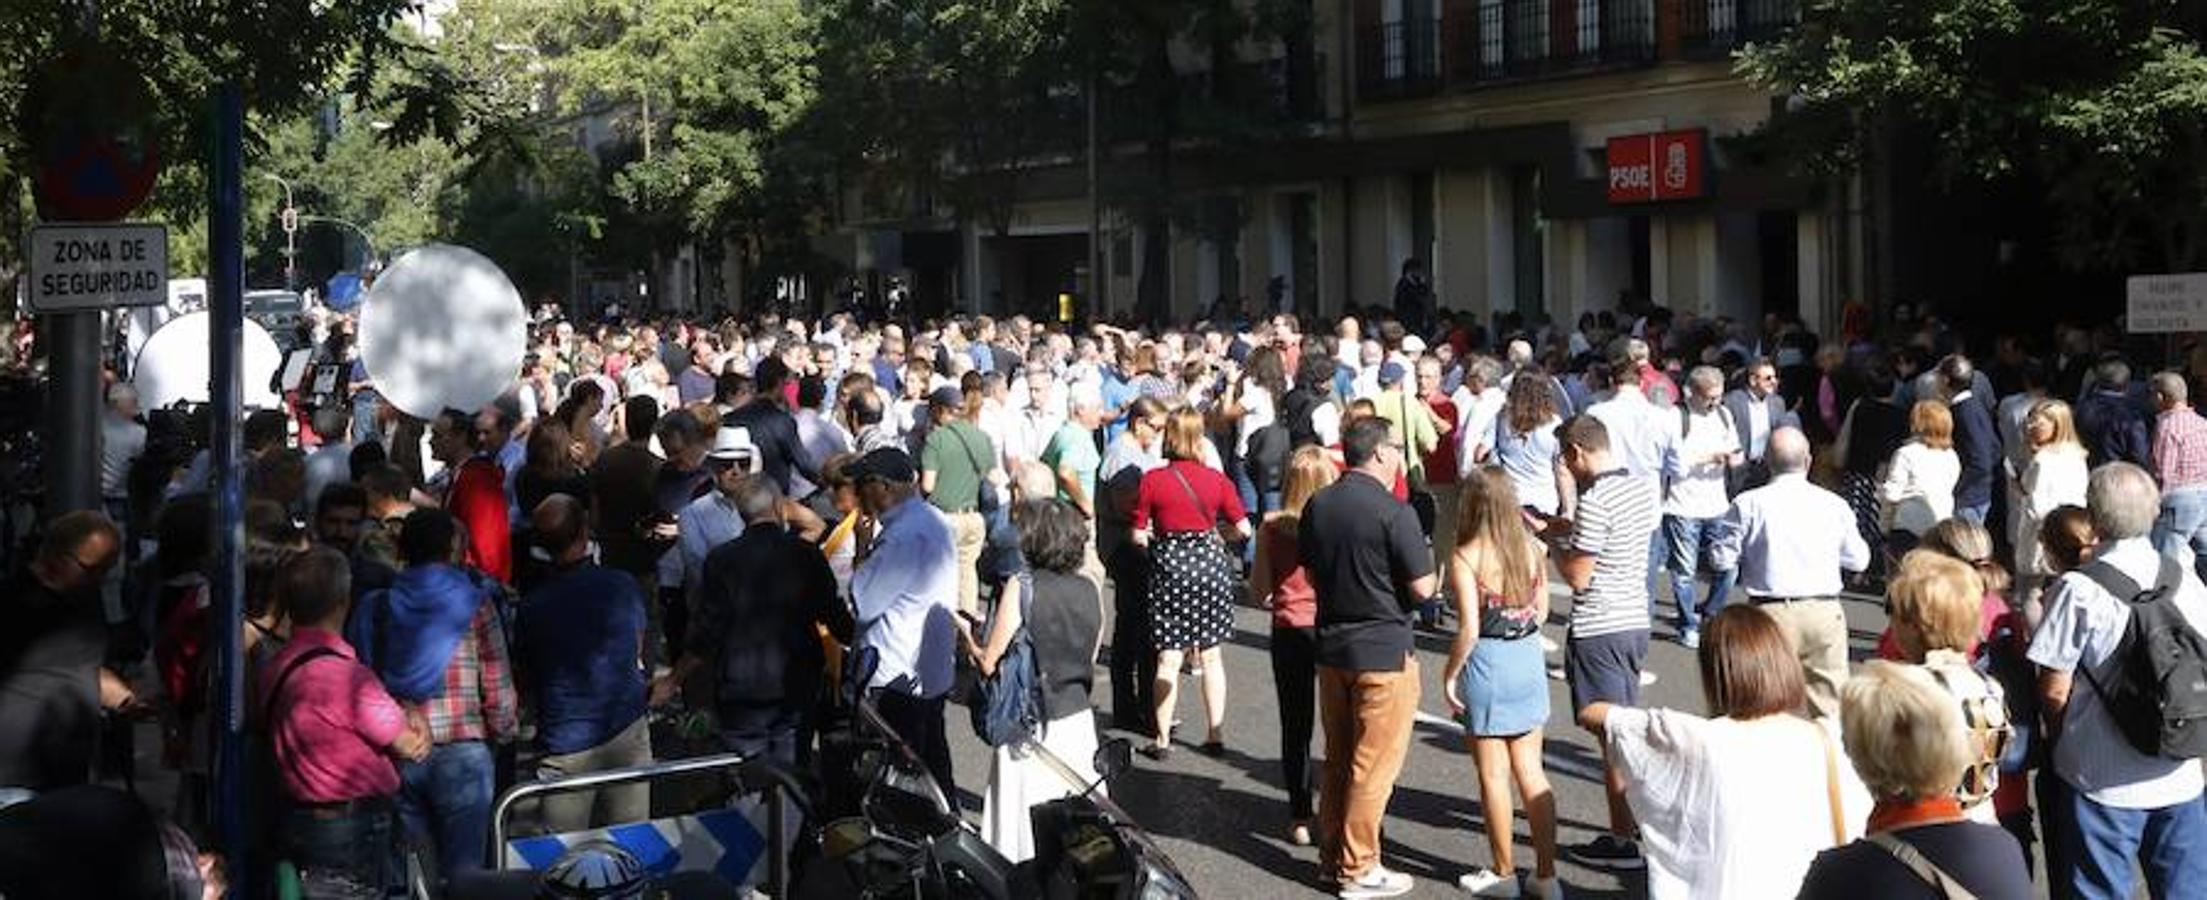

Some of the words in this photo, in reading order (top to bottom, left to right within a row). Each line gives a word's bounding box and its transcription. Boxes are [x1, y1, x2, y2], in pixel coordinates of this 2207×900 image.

[1610, 165, 1649, 190] PSOE
[54, 240, 111, 263] ZONA
[121, 240, 145, 261] DE
[43, 270, 158, 295] SEGURIDAD
